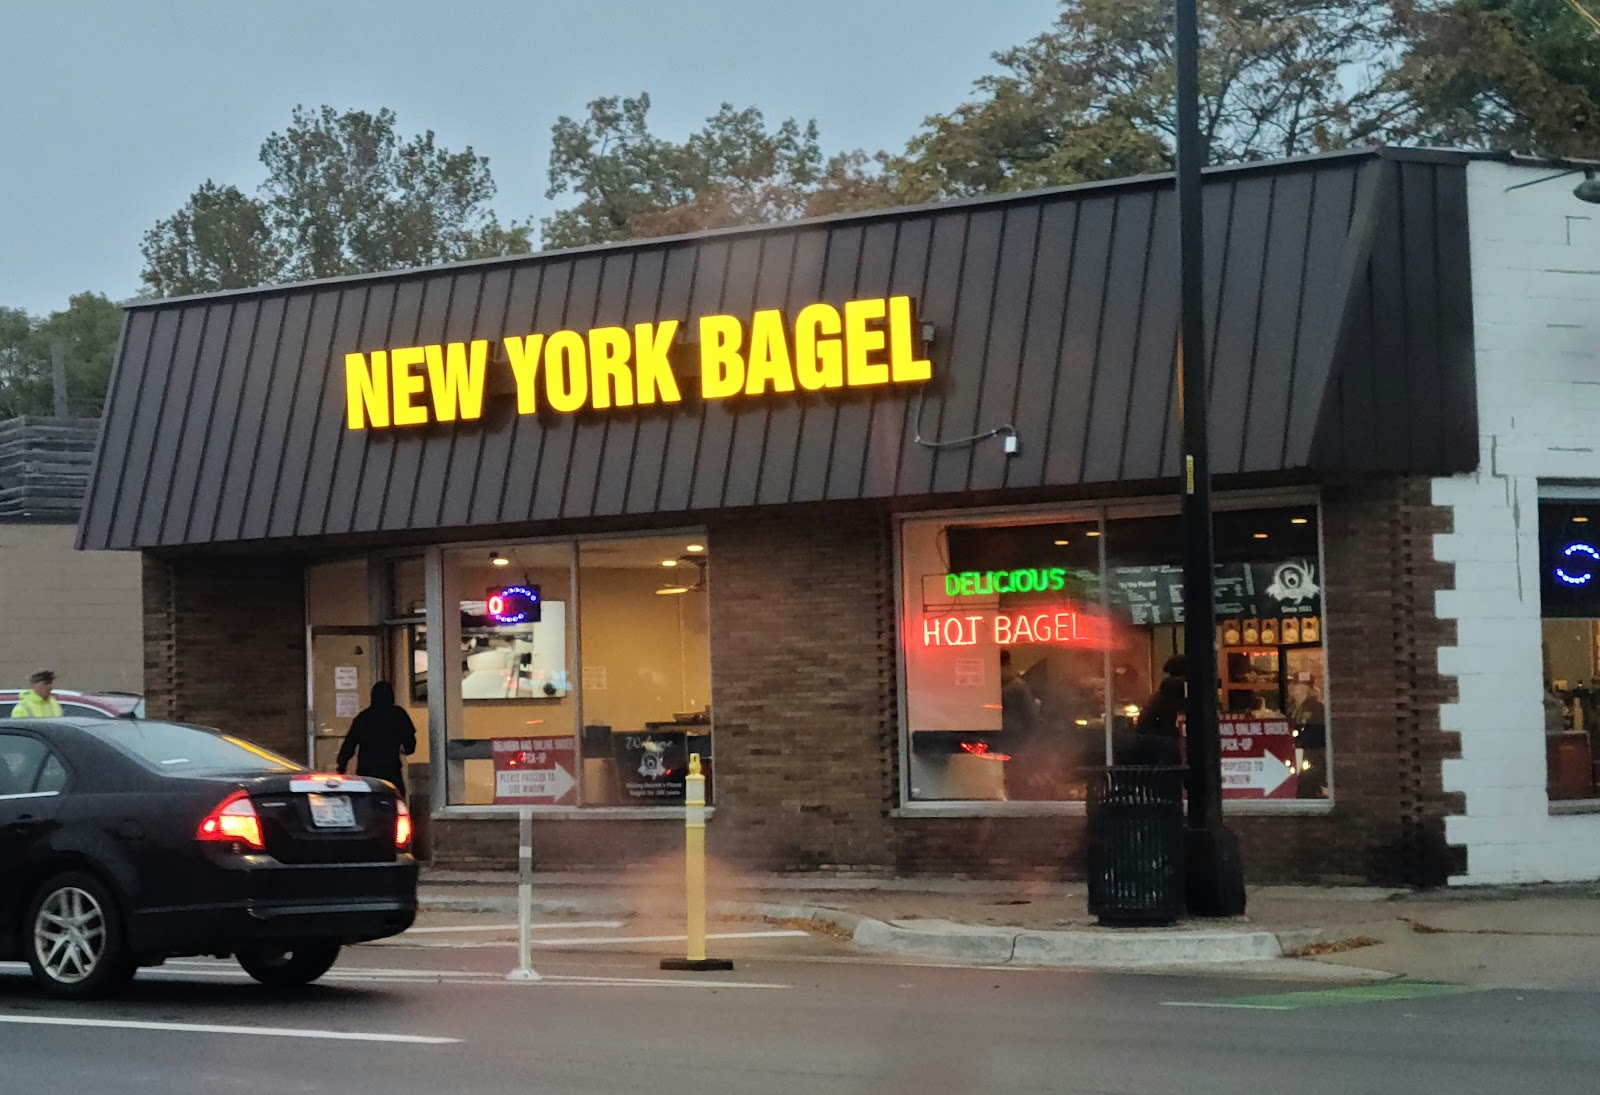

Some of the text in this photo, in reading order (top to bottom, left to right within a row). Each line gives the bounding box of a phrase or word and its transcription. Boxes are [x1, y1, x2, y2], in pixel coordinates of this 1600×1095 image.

[345, 296, 932, 430] NEW YORK BAGEL
[945, 567, 1066, 596] DELICIOUS
[923, 612, 1088, 647] HOT BAGEL
